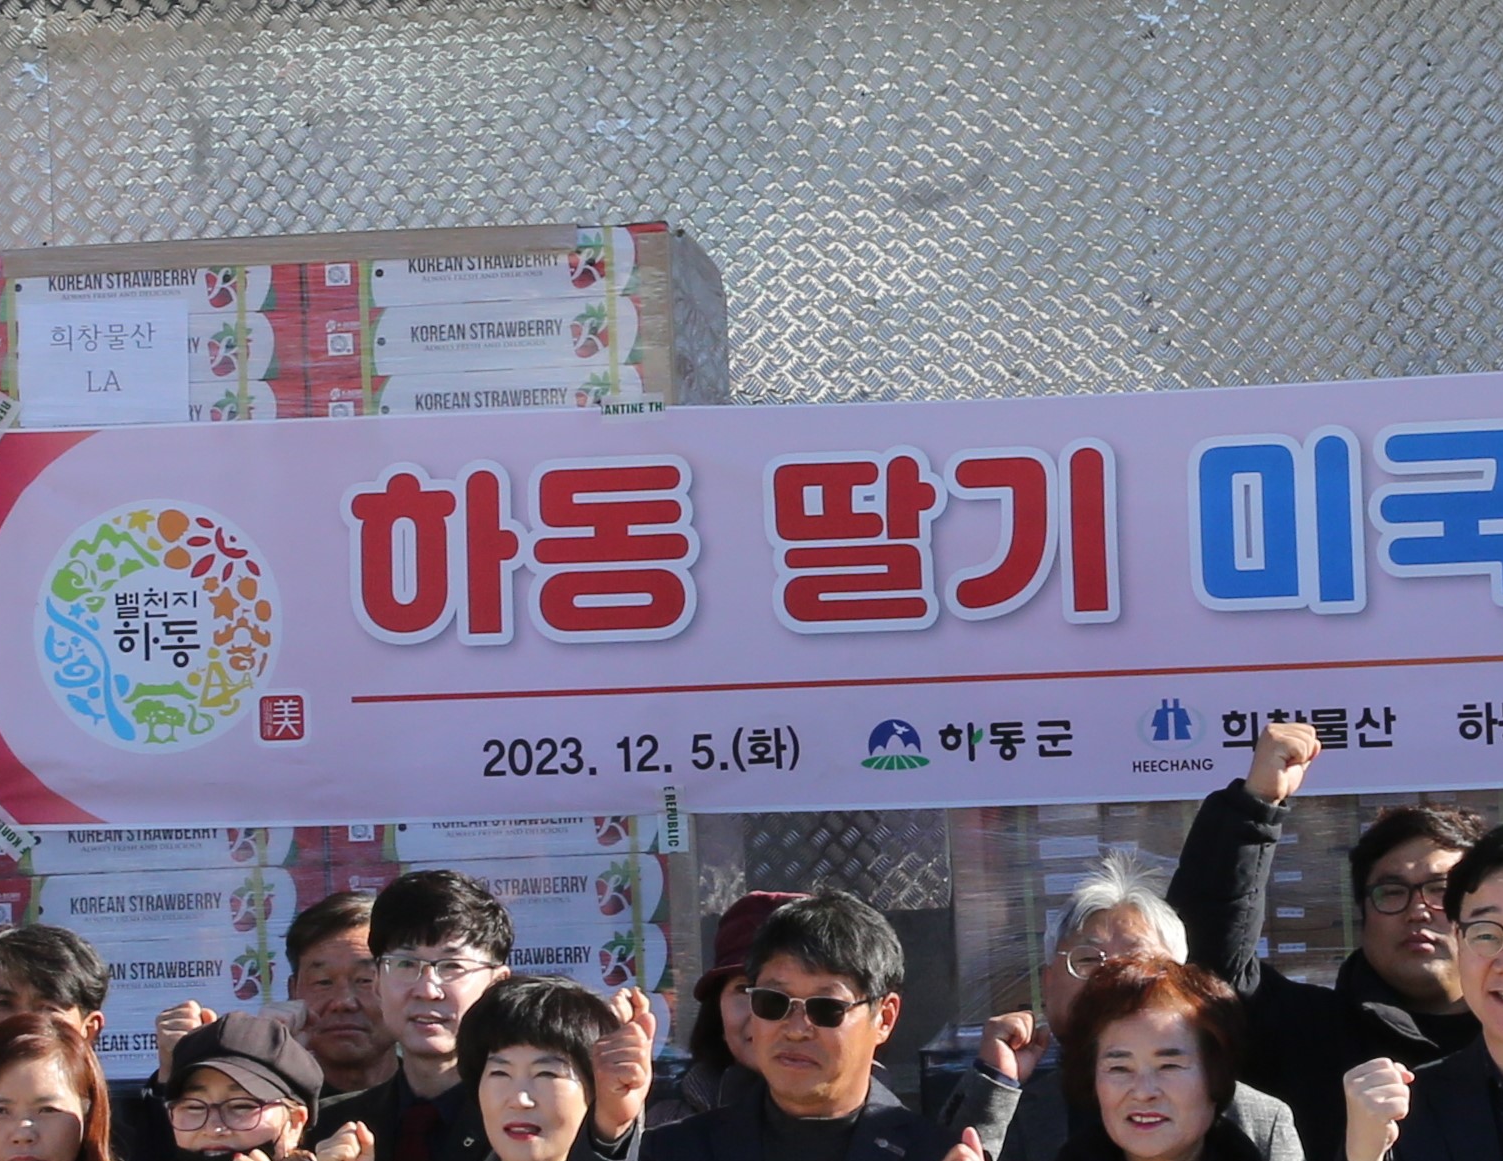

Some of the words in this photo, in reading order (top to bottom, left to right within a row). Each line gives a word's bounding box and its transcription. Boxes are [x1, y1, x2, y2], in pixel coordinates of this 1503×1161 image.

[408, 257, 463, 274] KOREAN
[466, 253, 559, 271] STRAWBERRY
[48, 271, 102, 292] KOREAN
[106, 268, 197, 290] STRAWBERRY
[49, 321, 158, 352] 희창물산
[410, 324, 466, 343] KOREAN
[468, 318, 563, 340] STRAWBERRY
[86, 369, 123, 393] LA
[415, 391, 470, 411] KOREAN
[473, 387, 568, 408] STRAWBERRY
[600, 401, 646, 416] ANTINE
[347, 461, 692, 638] 하동
[770, 443, 1111, 624] 딸기
[114, 587, 198, 620] 별천지
[113, 620, 201, 668] 하동
[272, 698, 302, 737] 美
[482, 737, 598, 778] 2023.
[616, 733, 673, 774] 12.
[690, 725, 800, 773] 5.(화)
[937, 719, 1075, 763] 하동군
[1131, 756, 1215, 775] HEECHANG
[664, 794, 680, 848] REPUBLIC
[494, 875, 588, 896] STRAWBERRY
[70, 896, 125, 915] KOREAN
[128, 892, 222, 912] STRAWBERRY
[508, 945, 591, 965] TRAWBERRY
[130, 959, 223, 980] STRAWBERRY
